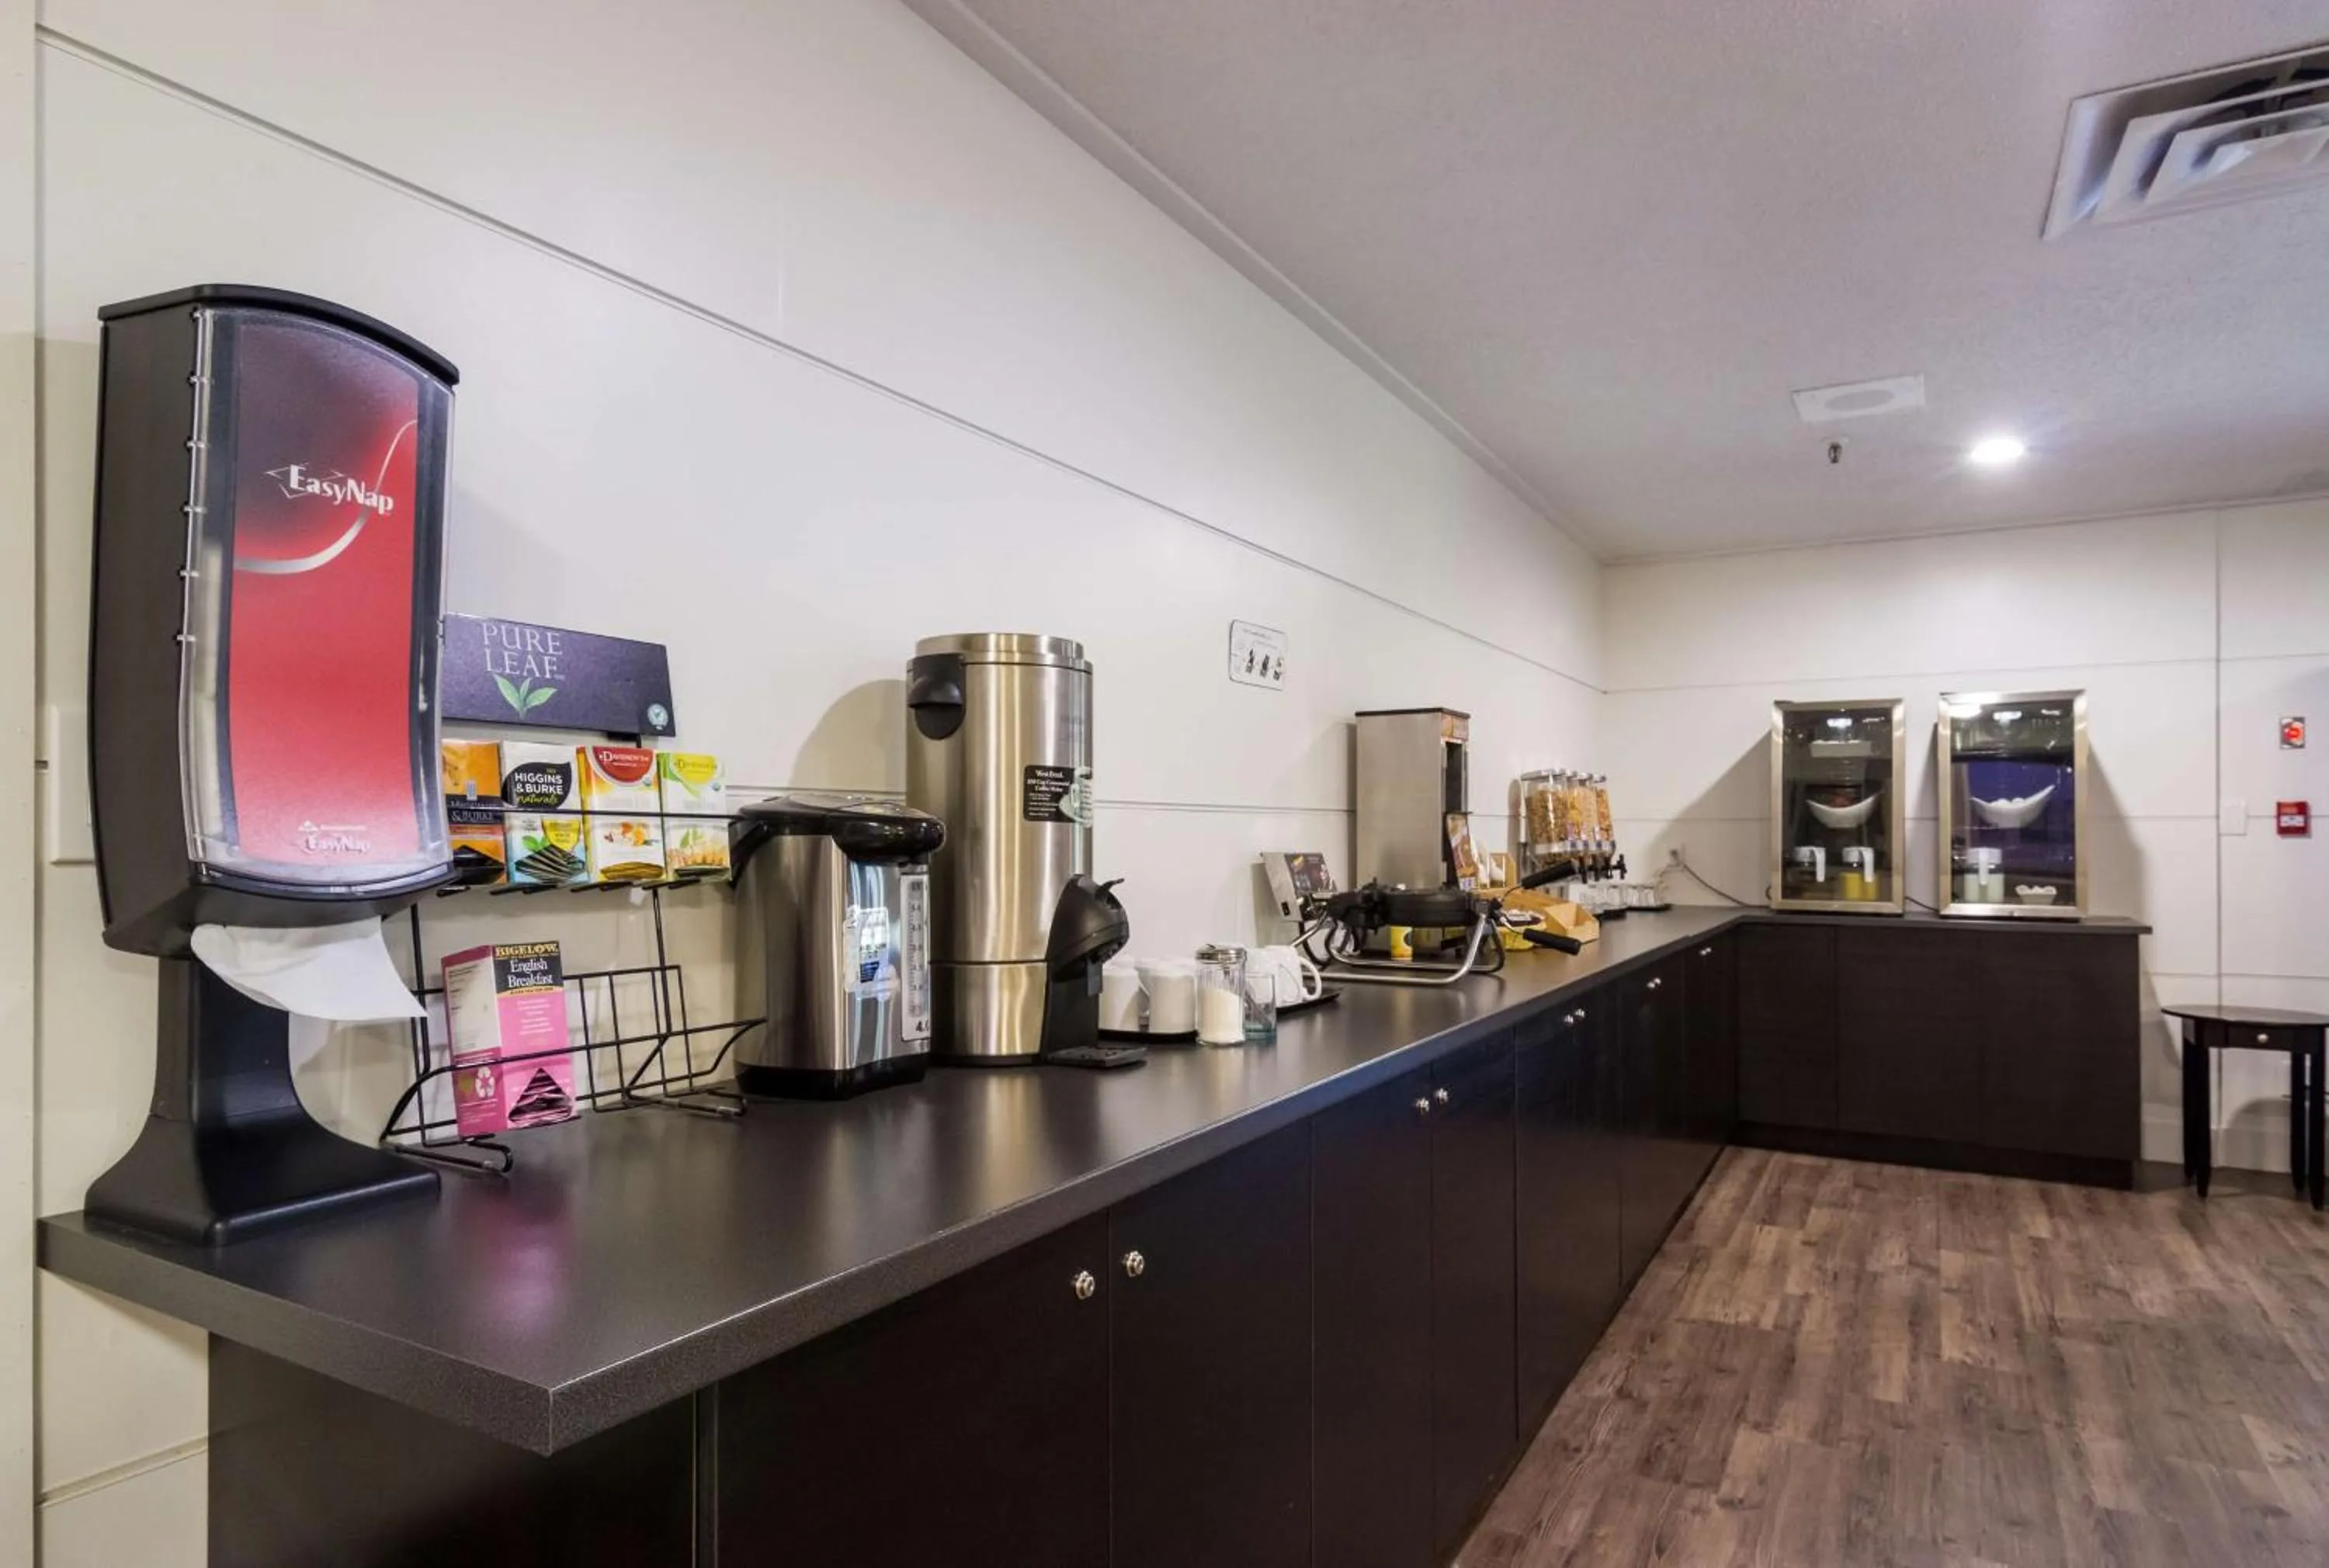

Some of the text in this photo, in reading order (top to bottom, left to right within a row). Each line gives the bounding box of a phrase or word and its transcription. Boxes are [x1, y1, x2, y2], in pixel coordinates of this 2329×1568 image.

[290, 463, 394, 515] EasyNap
[481, 622, 563, 655] PURE
[484, 647, 557, 678] LEAF
[515, 772, 563, 785] HIGGINS
[515, 782, 564, 796] & BURKE
[496, 943, 558, 956] BIGELOW
[509, 957, 548, 974] English
[507, 973, 554, 988] Breakfast
